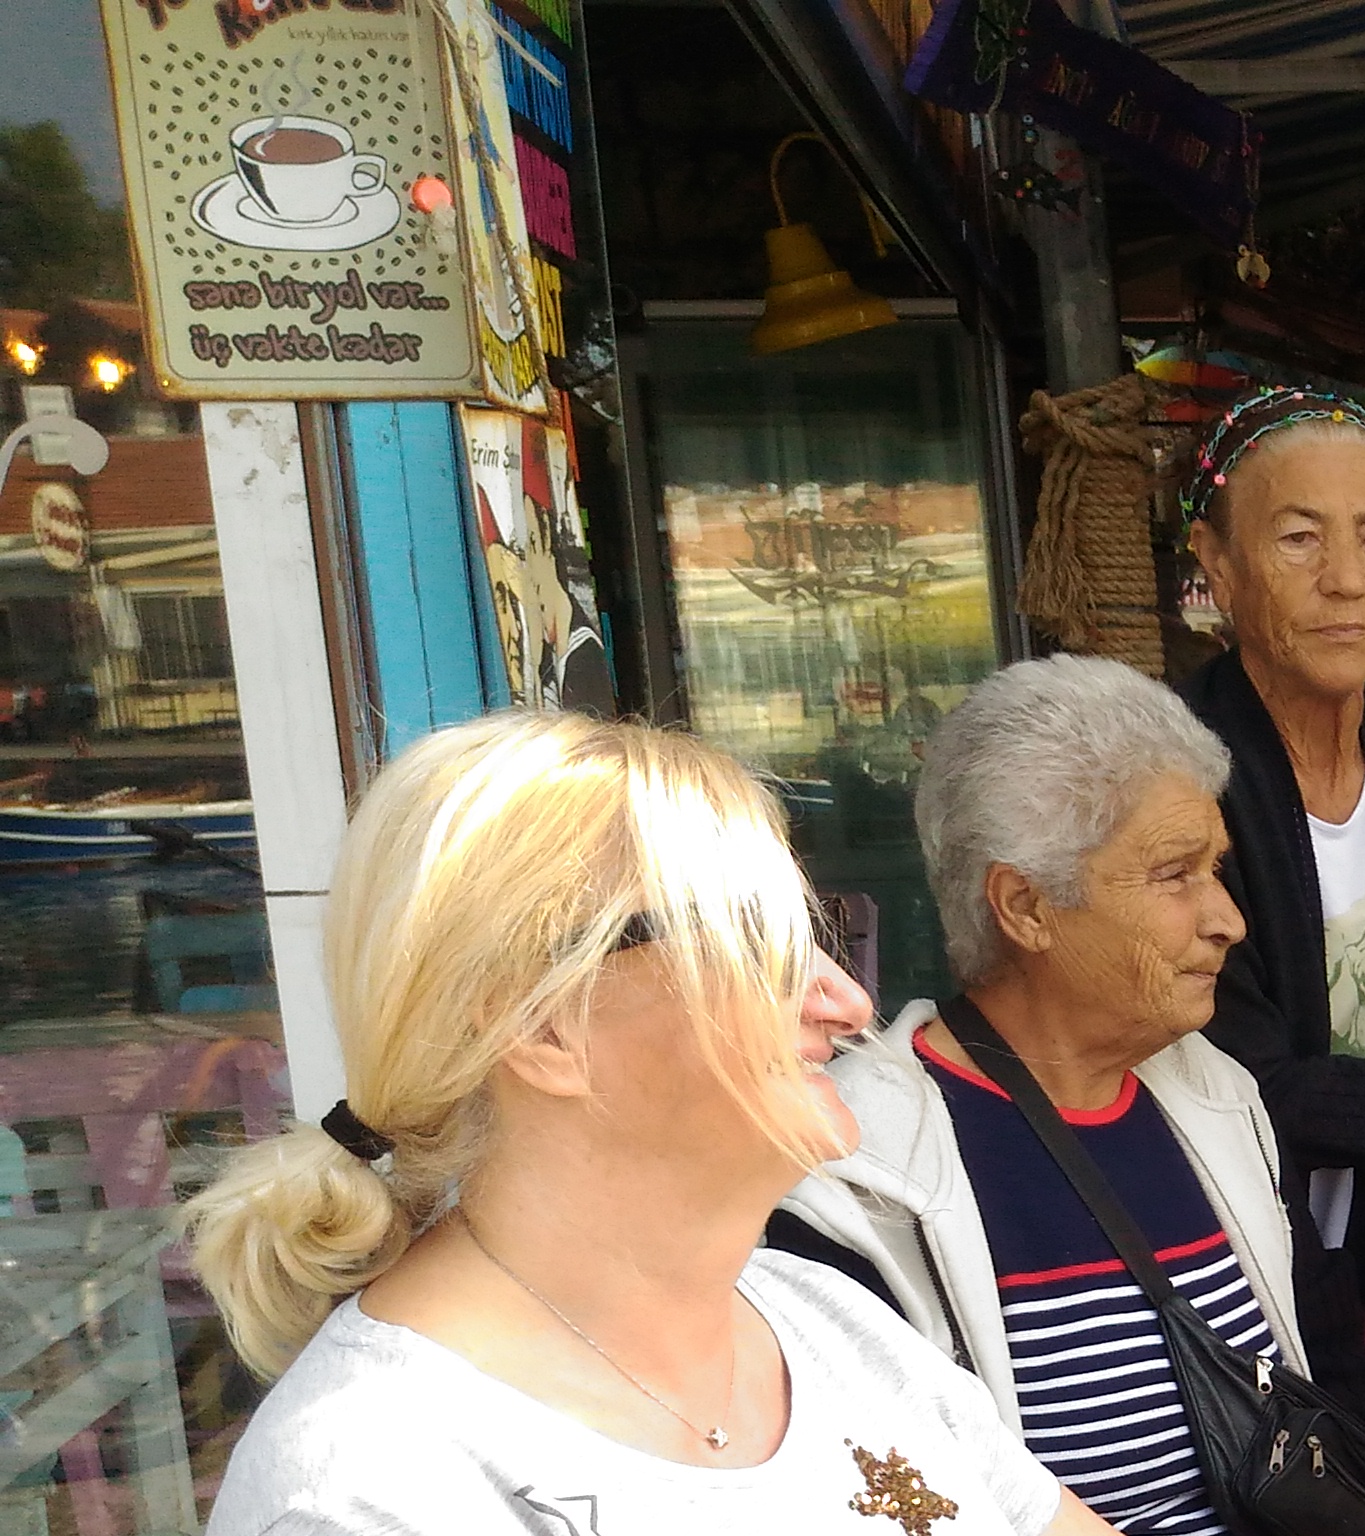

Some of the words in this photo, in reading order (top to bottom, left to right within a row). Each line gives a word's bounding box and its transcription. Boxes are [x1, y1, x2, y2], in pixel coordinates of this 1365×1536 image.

[184, 281, 261, 309] sana
[259, 270, 313, 309] bir
[310, 268, 367, 324] yol
[189, 323, 232, 367] üç
[232, 323, 329, 361] vakte
[327, 322, 423, 363] kadar
[471, 438, 499, 468] Erim
